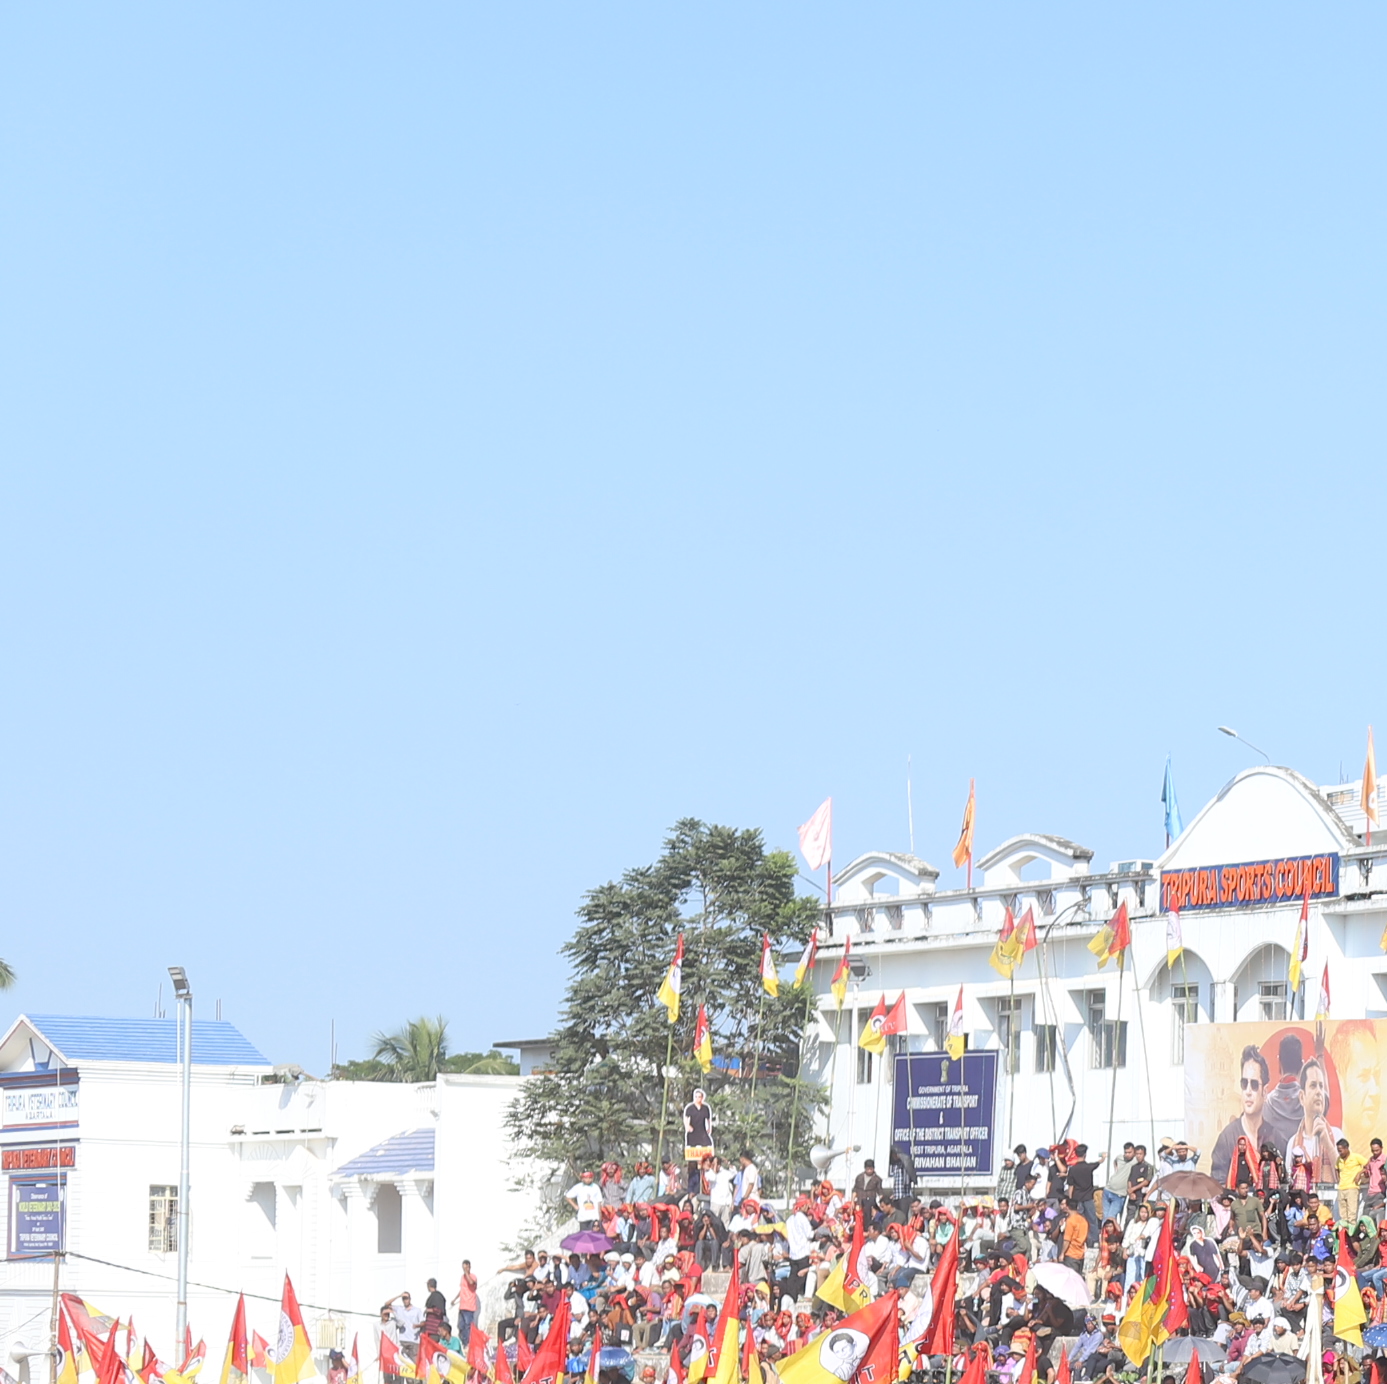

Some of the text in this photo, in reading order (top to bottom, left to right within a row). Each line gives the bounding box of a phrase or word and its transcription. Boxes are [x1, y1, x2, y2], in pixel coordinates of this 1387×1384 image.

[1162, 856, 1335, 908] TRIPURA SPORTS COUNCIL
[918, 1086, 944, 1094] GOVERNMENT
[946, 1085, 951, 1093] OF
[947, 1096, 953, 1108] OF
[939, 1111, 944, 1125] &
[895, 1128, 909, 1141] OFFICE
[916, 1127, 925, 1140] THE
[925, 1127, 945, 1140] DISTRICT
[970, 1127, 988, 1140] OFFICER
[914, 1156, 976, 1168] RIVAHAN BHAWAN
